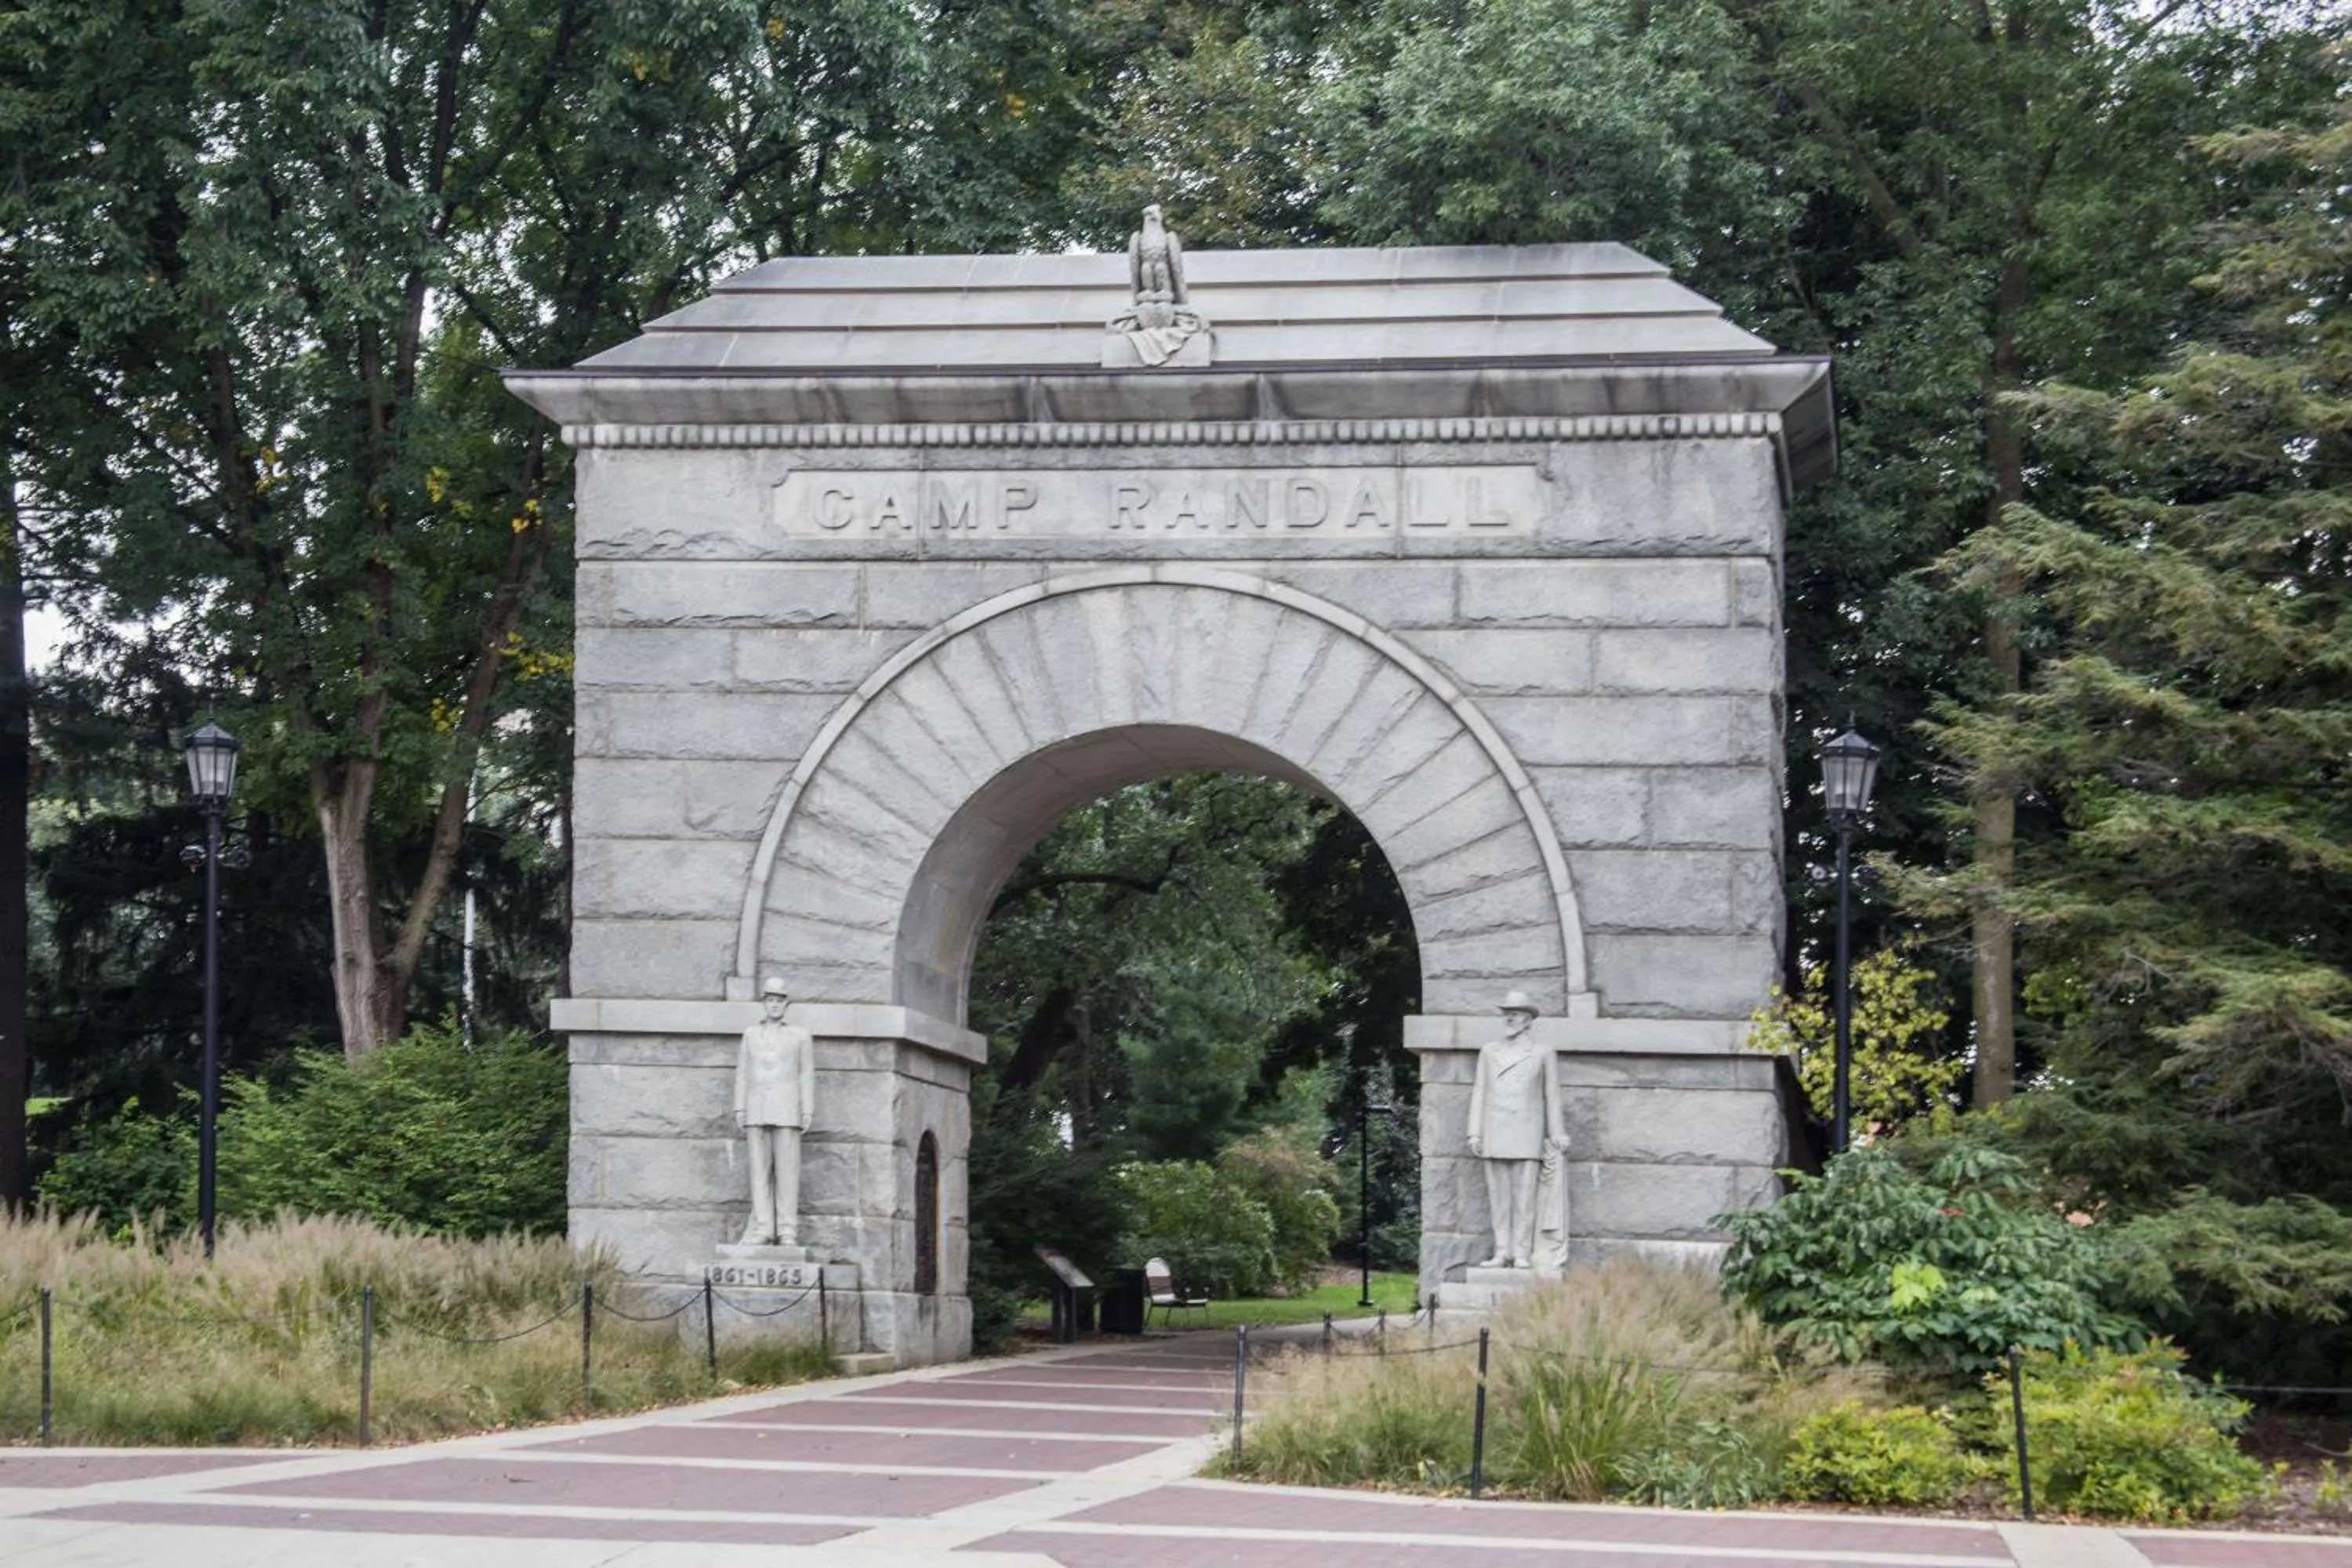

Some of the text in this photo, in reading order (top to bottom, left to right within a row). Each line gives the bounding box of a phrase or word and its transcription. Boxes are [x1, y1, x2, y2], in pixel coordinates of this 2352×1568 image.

[814, 477, 1510, 530] CAMP RANDALL
[703, 1266, 802, 1285] 1861-1865
